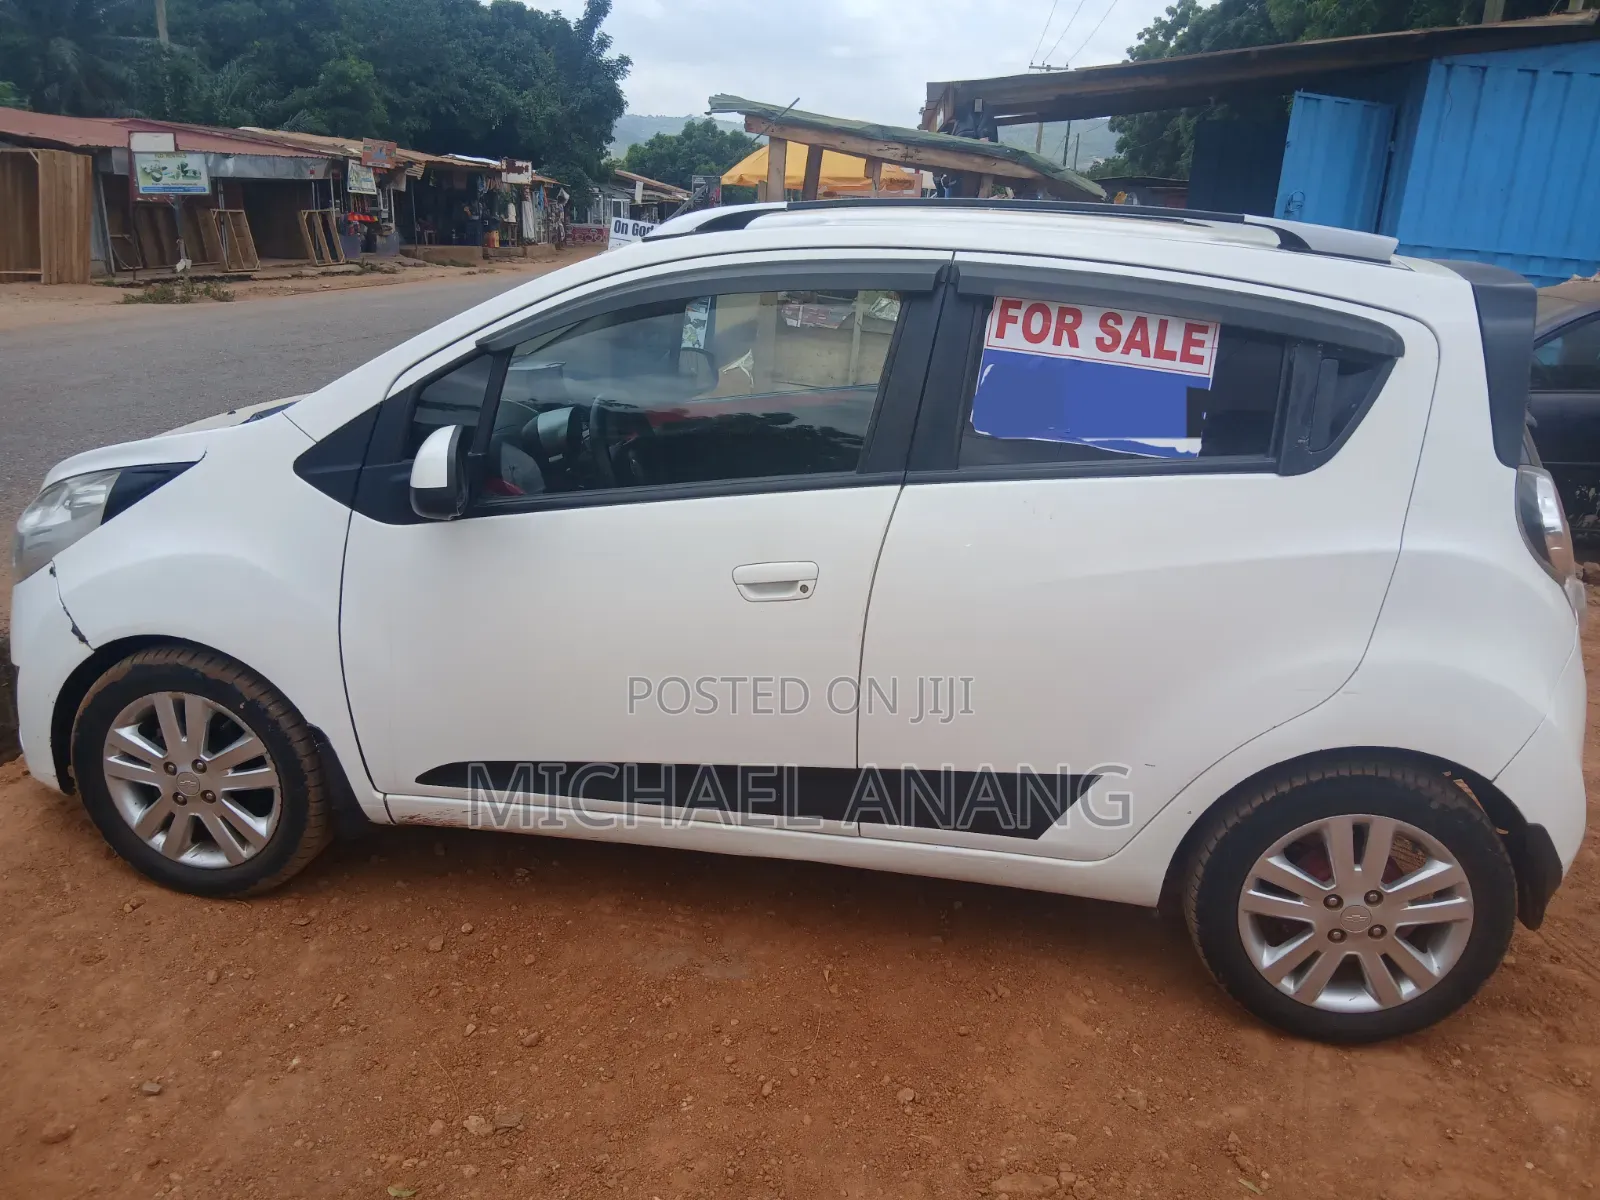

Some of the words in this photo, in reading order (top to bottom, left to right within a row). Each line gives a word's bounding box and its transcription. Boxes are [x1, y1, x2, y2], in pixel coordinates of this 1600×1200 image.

[613, 219, 629, 235] On
[995, 299, 1083, 349] FOR
[1095, 311, 1210, 366] SALE
